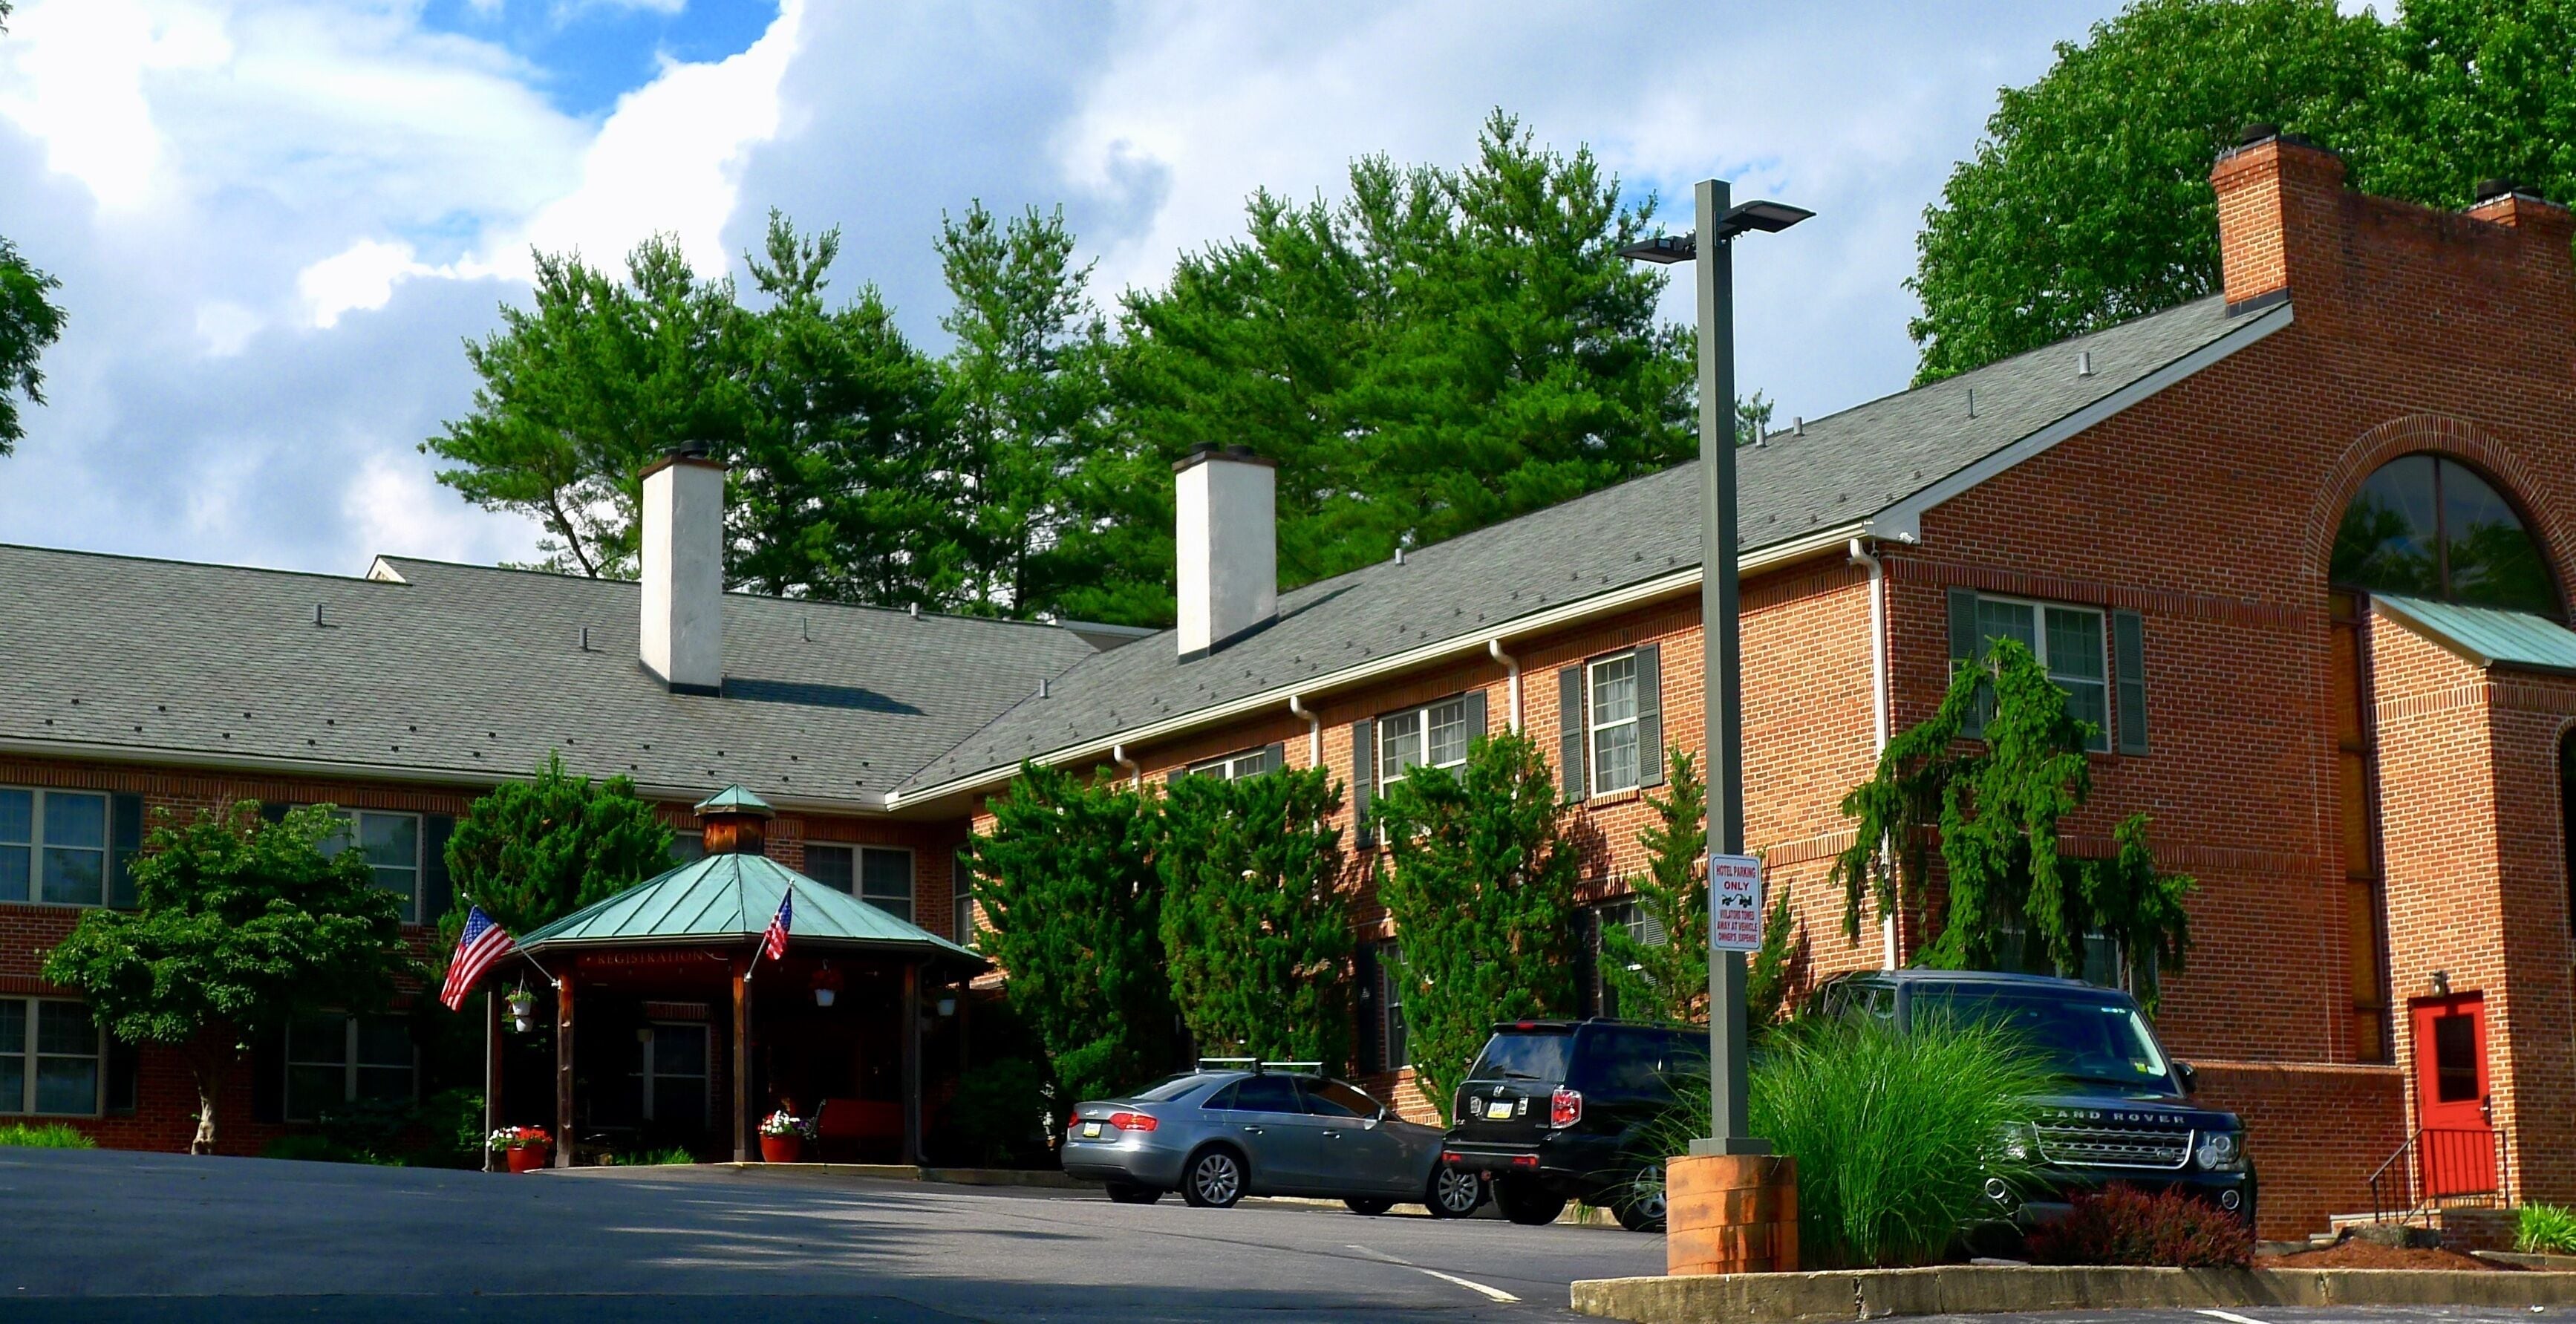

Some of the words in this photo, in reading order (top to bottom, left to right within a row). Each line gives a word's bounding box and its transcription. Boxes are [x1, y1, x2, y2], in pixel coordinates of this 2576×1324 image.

[1716, 864, 1732, 877] HOTEL
[1734, 866, 1755, 878] PARKING
[1724, 881, 1749, 891] ONLY
[1731, 922, 1738, 930] AT
[598, 950, 703, 965] REGISTRATION
[2042, 1110, 2101, 1120] LAND
[2113, 1113, 2185, 1124] ROVER
